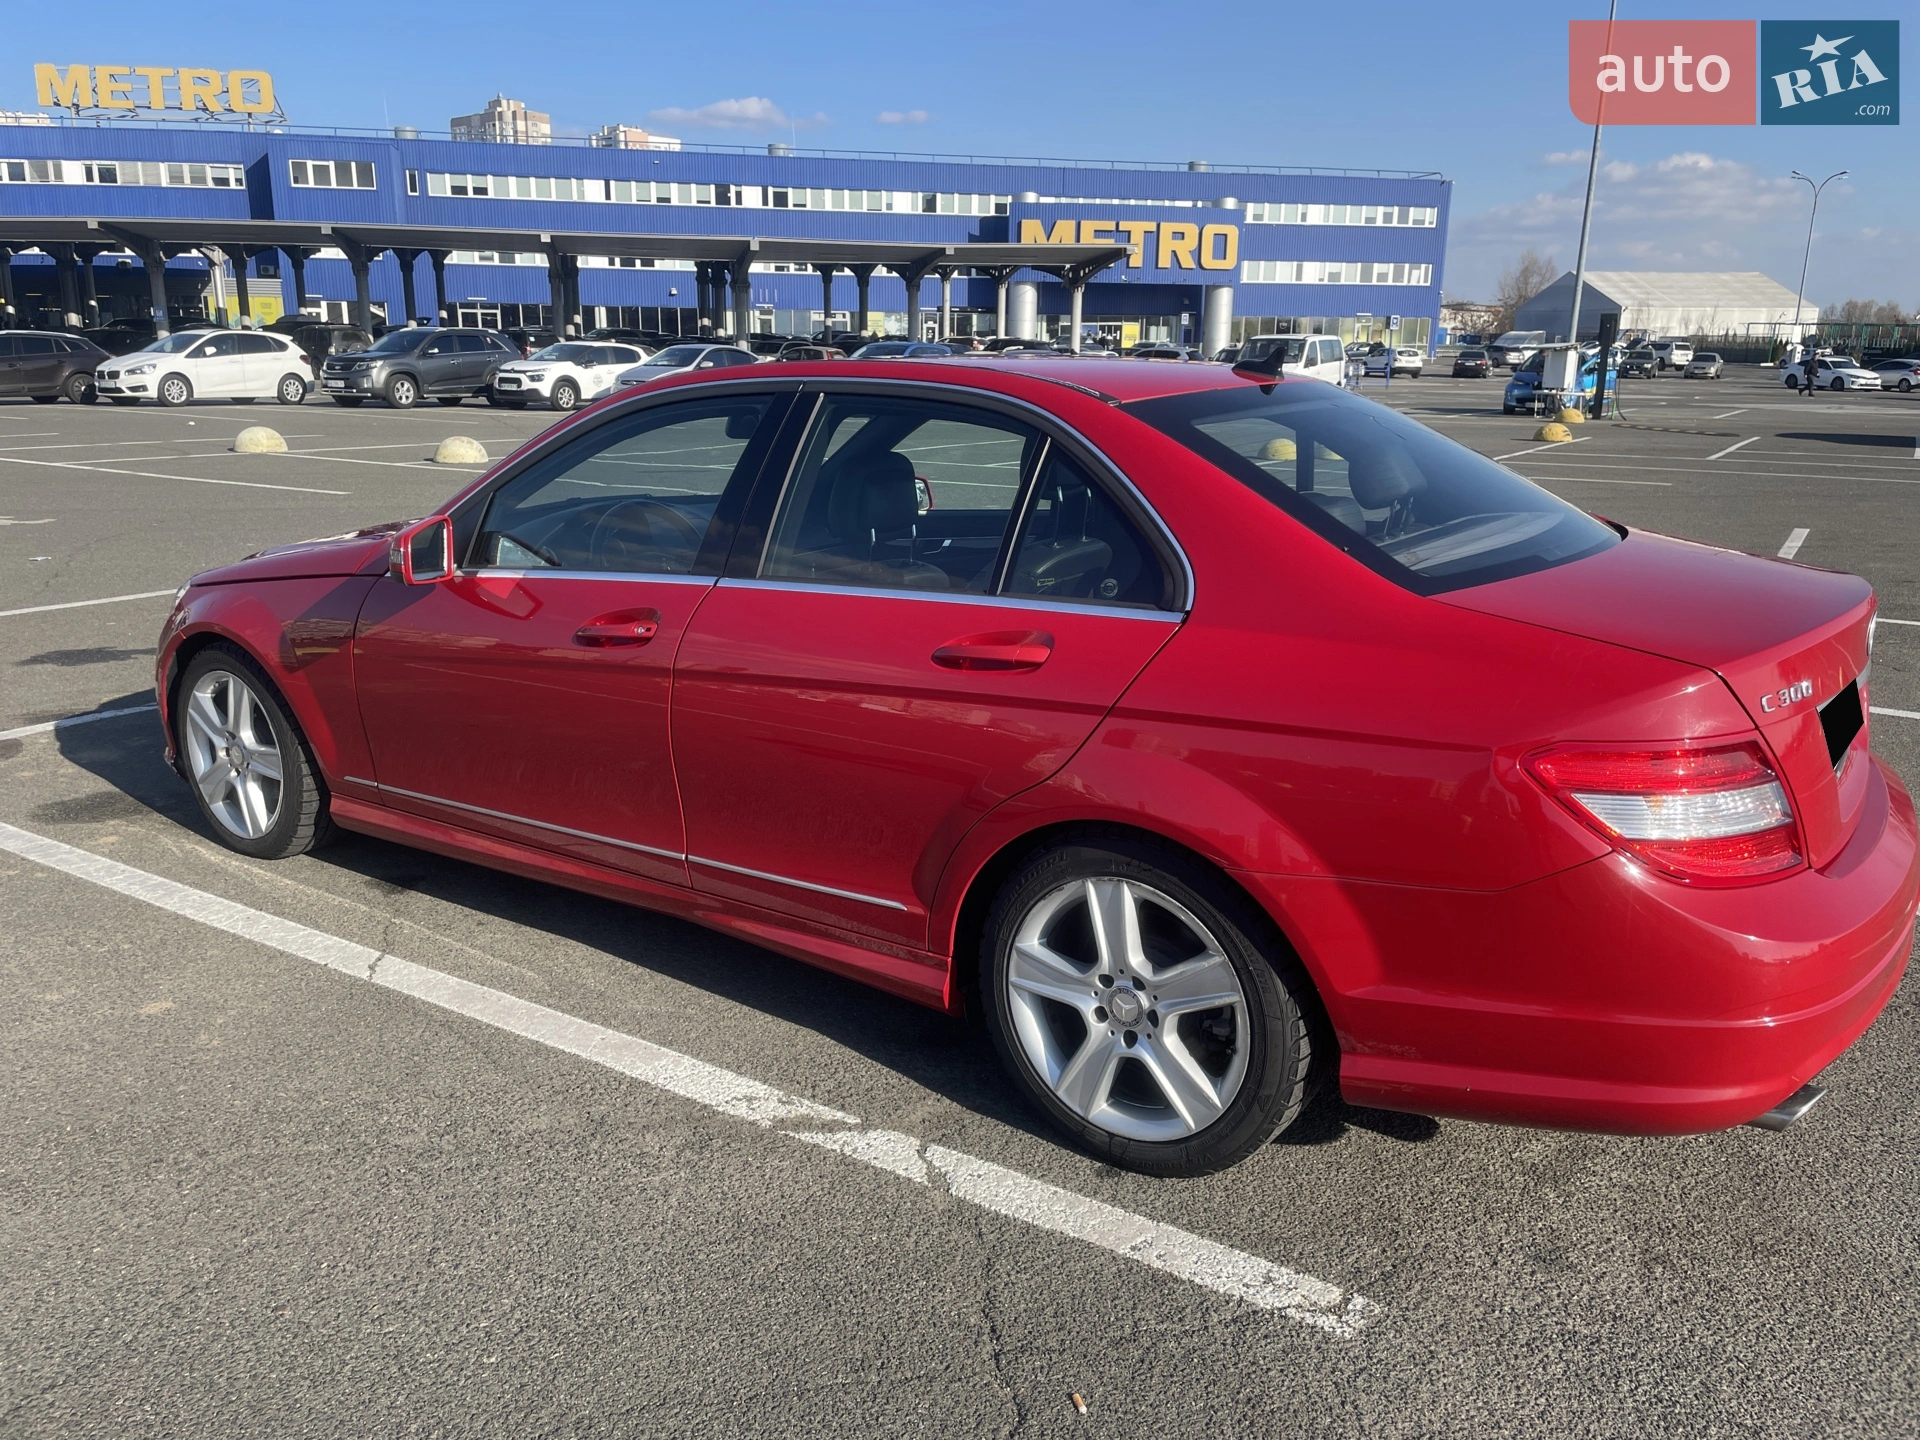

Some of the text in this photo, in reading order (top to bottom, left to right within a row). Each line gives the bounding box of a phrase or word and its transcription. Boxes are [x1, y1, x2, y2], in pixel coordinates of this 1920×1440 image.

[34, 63, 275, 113] METRO
[1020, 218, 1239, 270] METRO
[1760, 680, 1812, 713] C 300
